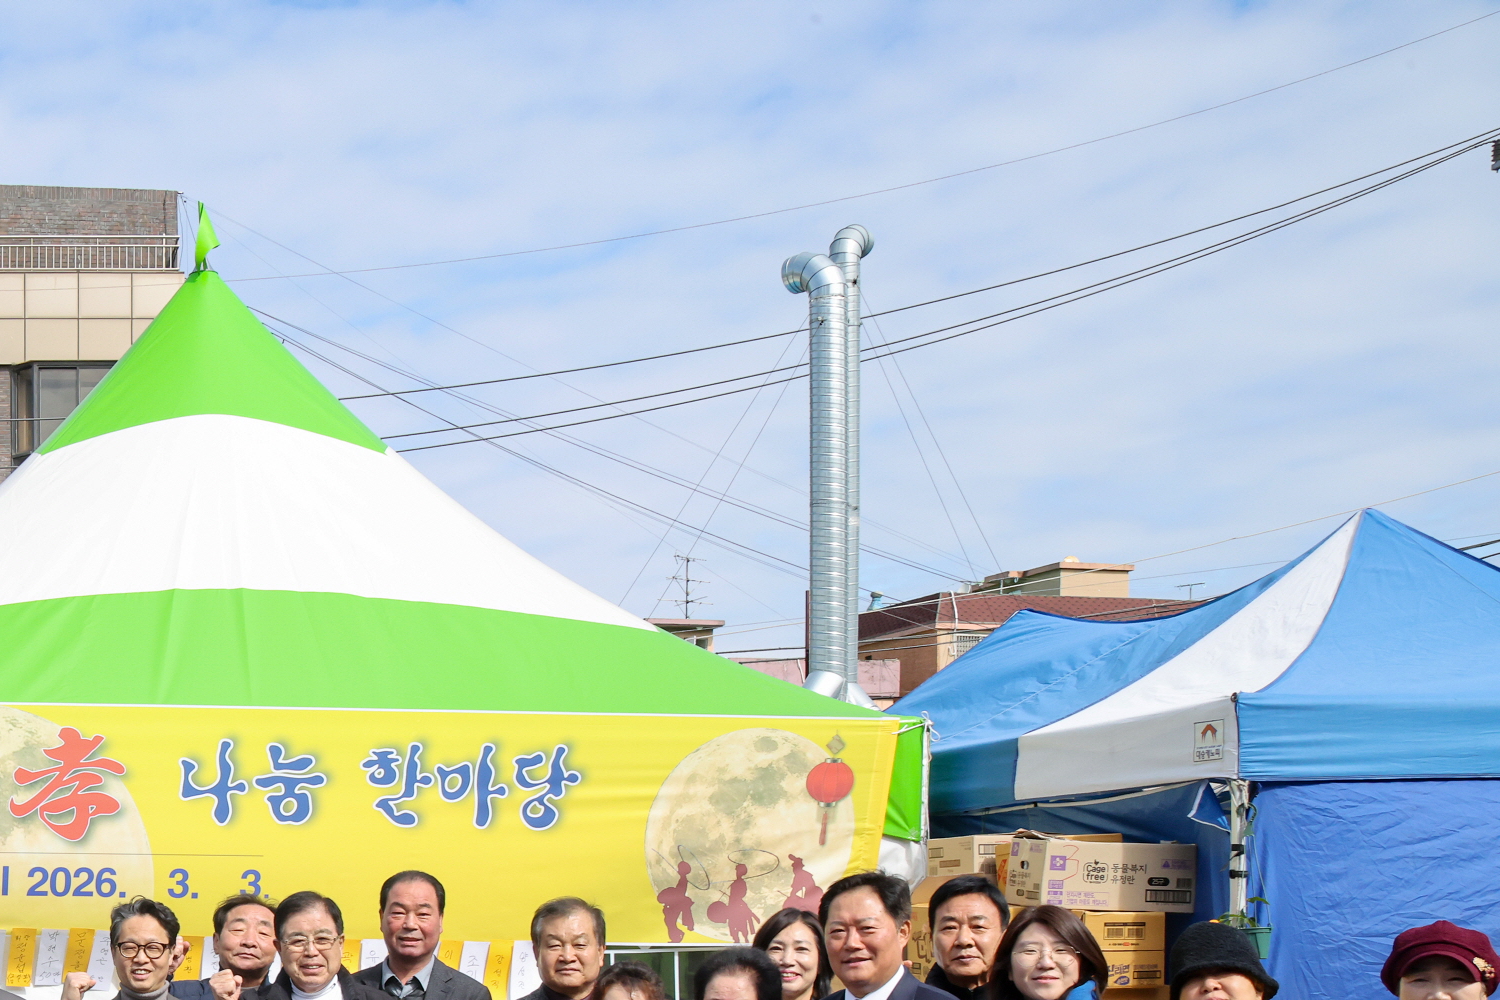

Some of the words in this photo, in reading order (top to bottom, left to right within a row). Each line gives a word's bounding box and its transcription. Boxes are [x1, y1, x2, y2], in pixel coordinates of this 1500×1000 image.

[9, 726, 128, 842] 孝
[180, 738, 329, 827] 나눔
[361, 741, 583, 831] 한마당
[1086, 864, 1106, 874] Cage
[1111, 863, 1147, 874] 동물복지
[27, 866, 126, 898] 2026.
[168, 868, 199, 899] 3.
[1086, 873, 1105, 881] free
[1110, 874, 1135, 885] 유정란
